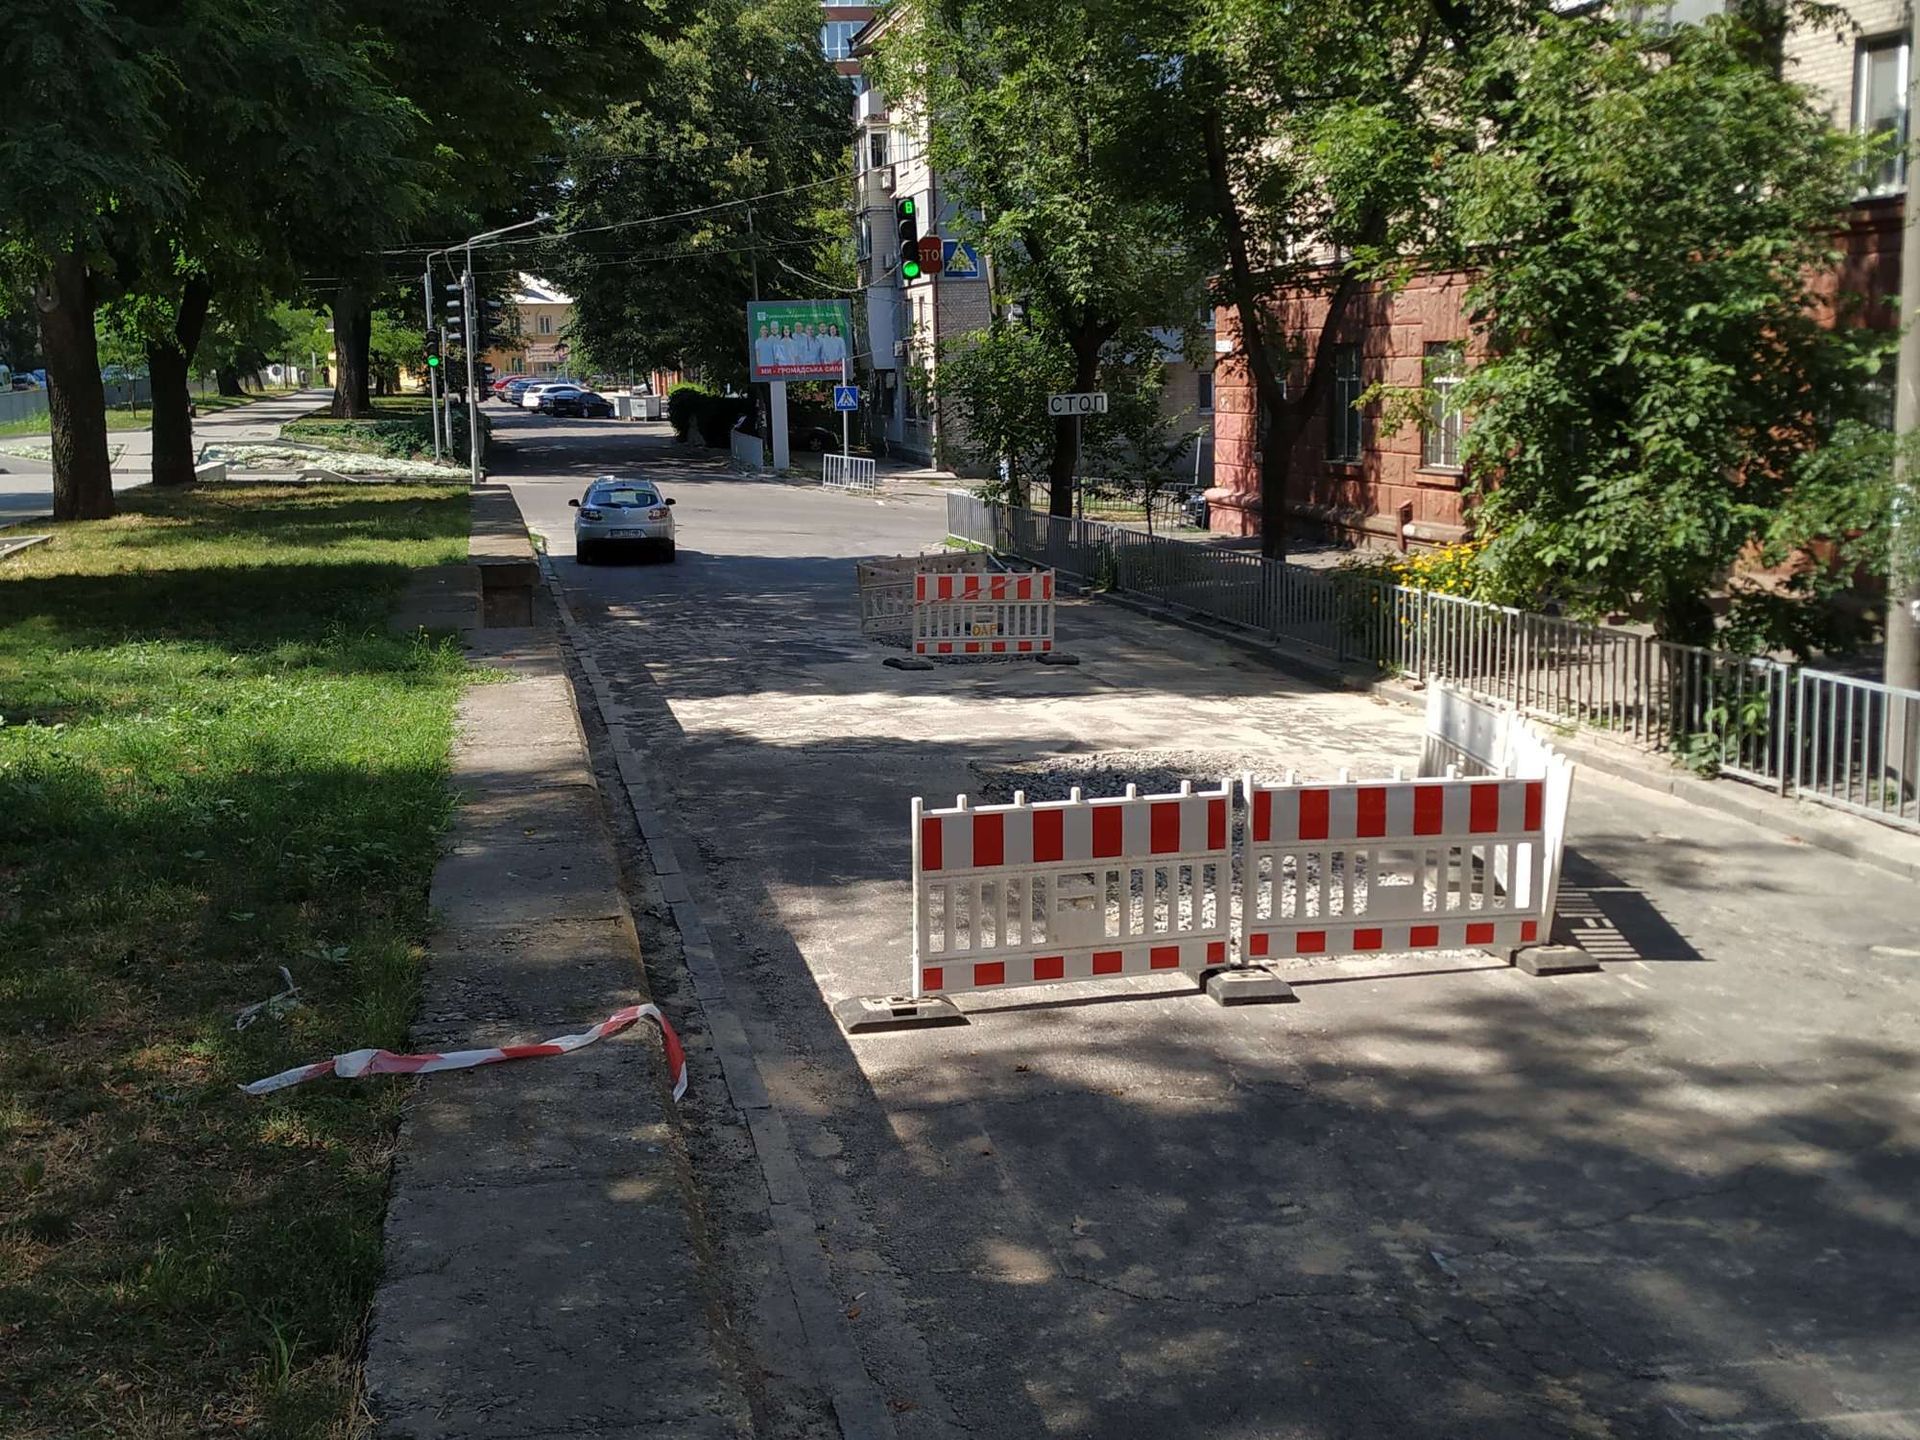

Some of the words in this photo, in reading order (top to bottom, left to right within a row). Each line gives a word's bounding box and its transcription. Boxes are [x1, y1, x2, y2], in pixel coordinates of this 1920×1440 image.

[778, 366, 823, 375] ГРОМАДСЬКА
[824, 365, 843, 373] СИЛА
[1051, 396, 1104, 413] СТОП
